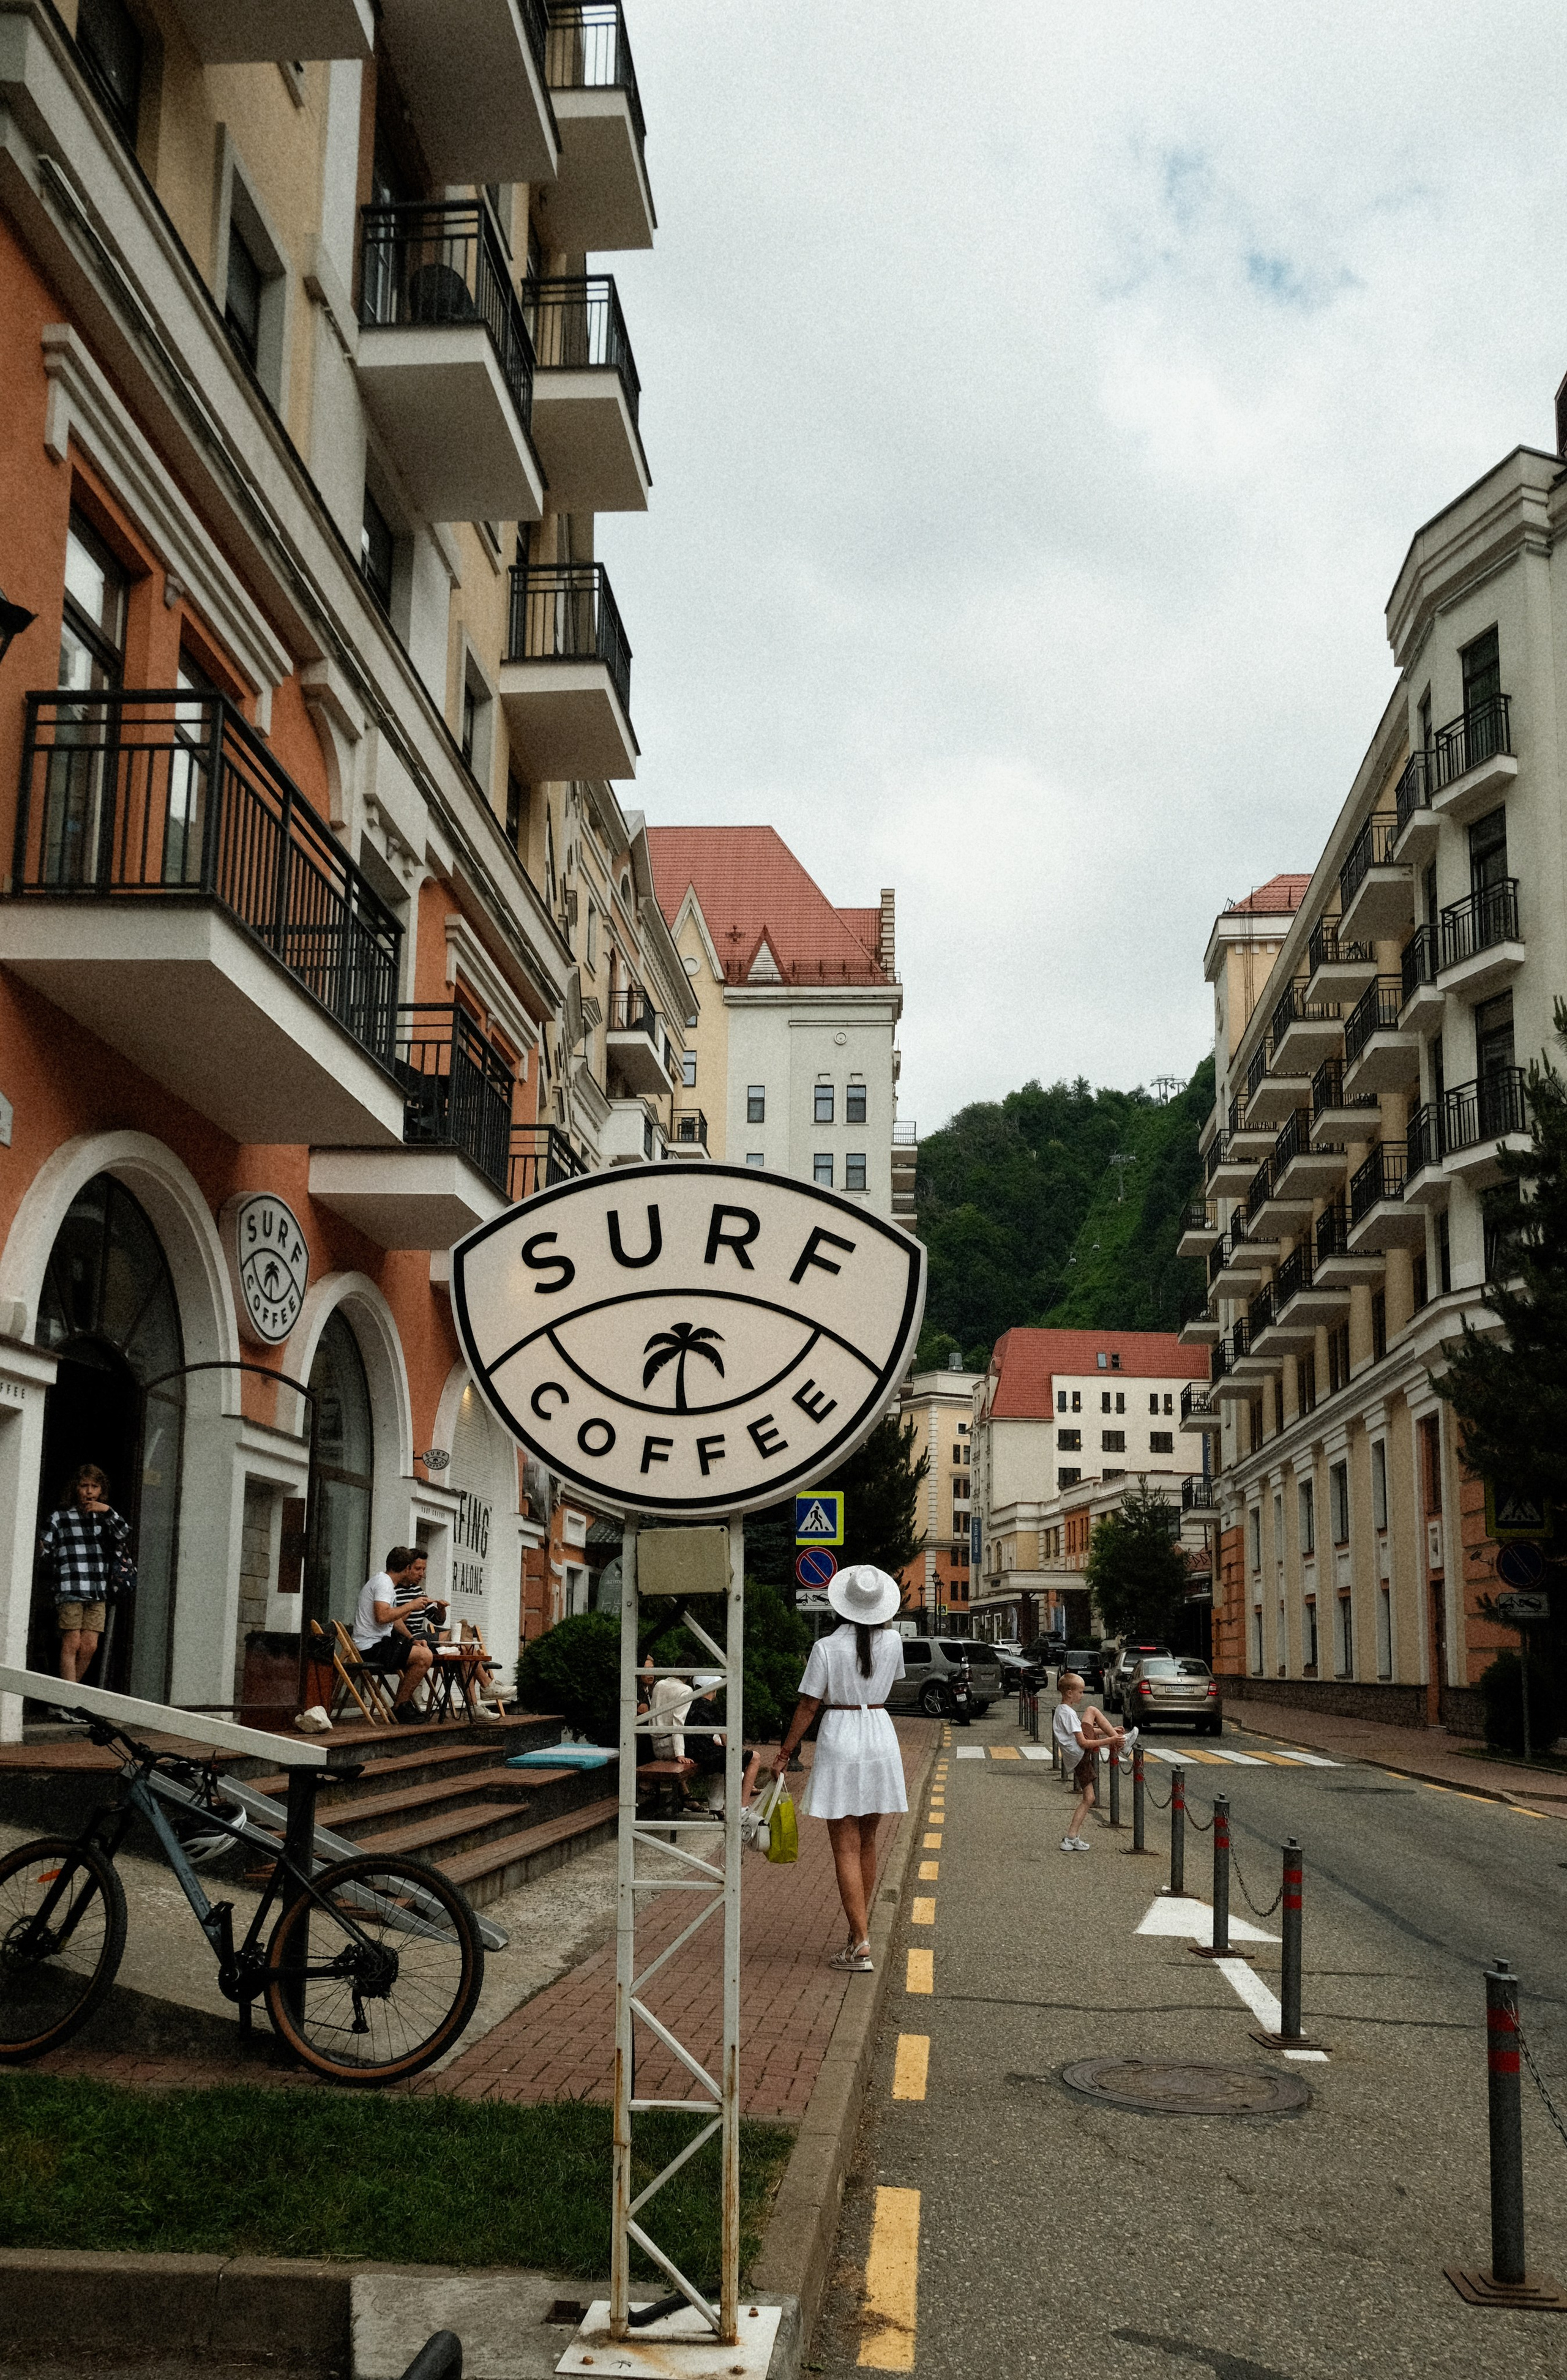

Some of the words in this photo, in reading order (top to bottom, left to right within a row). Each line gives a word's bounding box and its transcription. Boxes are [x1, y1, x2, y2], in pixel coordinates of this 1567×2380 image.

[247, 1209, 303, 1264] SURF
[521, 1203, 856, 1294] SURF
[246, 1274, 297, 1329] COFFEE
[529, 1378, 838, 1476] COFFEE
[426, 1459, 445, 1469] COFFEE
[460, 1562, 483, 1595] ALONE
